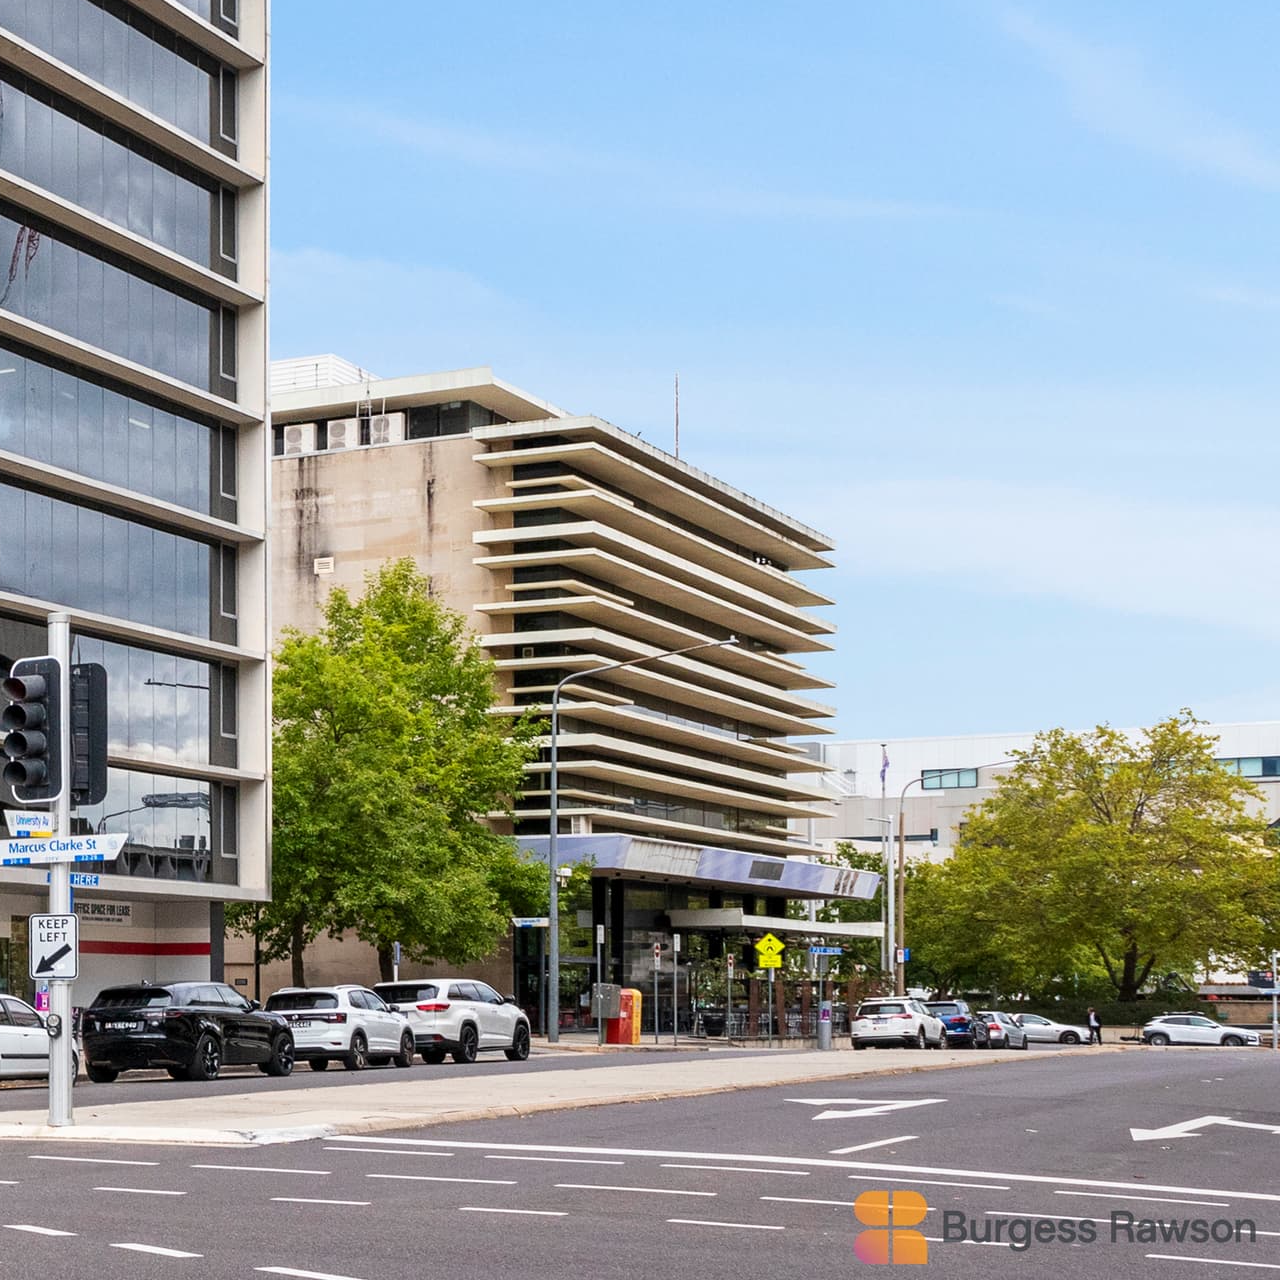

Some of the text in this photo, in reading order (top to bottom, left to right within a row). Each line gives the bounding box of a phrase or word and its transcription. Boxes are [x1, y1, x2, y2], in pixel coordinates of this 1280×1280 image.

[16, 815, 40, 829] University
[9, 838, 96, 853] Marcus Clarke St
[74, 875, 97, 886] HERE
[38, 919, 69, 929] KEEP
[40, 932, 68, 942] LEFT
